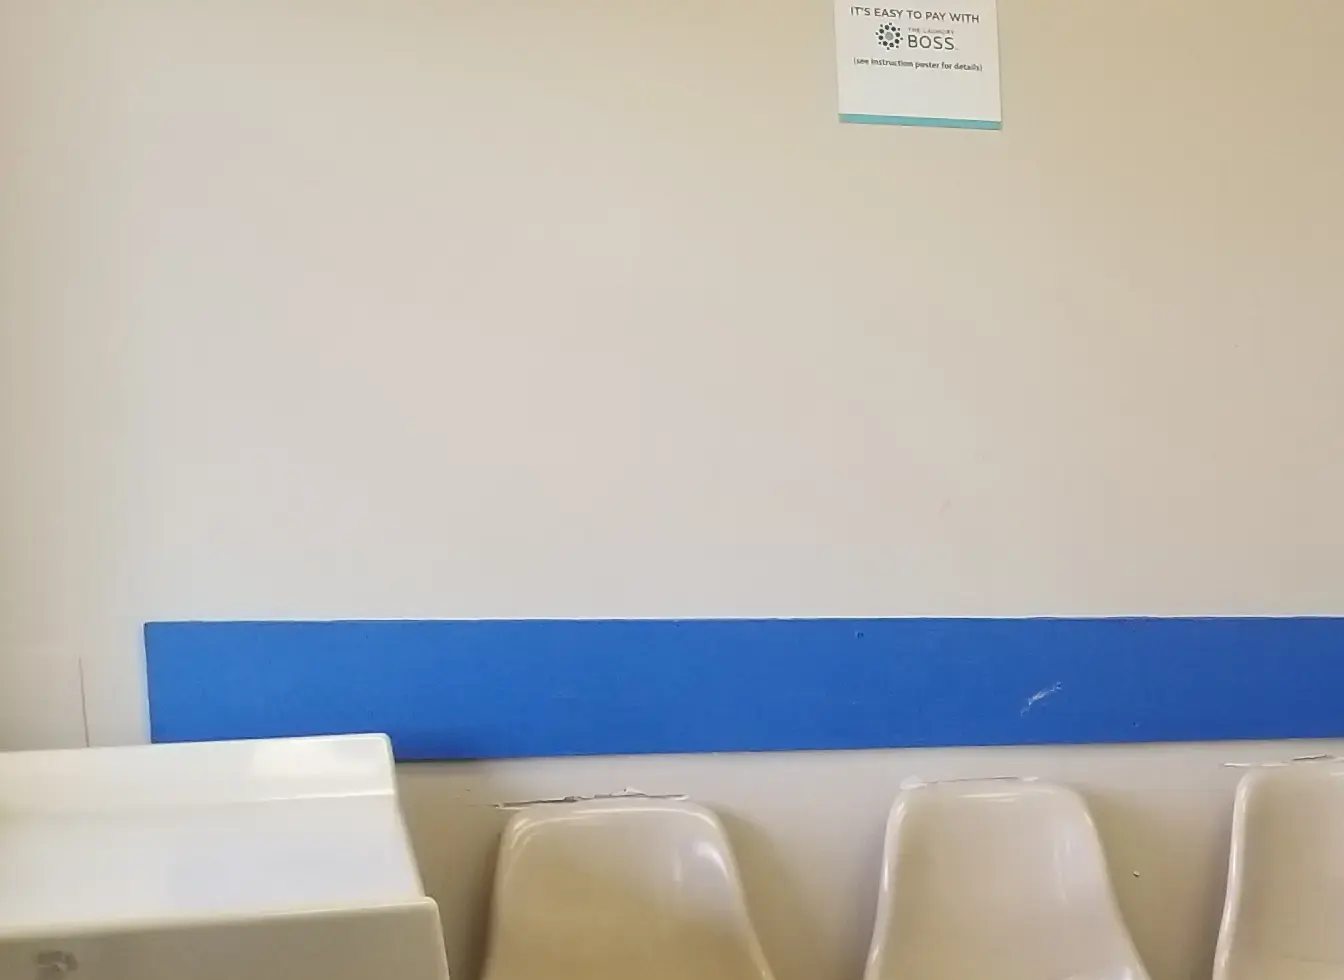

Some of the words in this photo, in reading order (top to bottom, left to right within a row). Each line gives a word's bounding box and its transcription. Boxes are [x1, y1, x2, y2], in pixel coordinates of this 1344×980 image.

[850, 6, 871, 16] IT'S
[874, 8, 903, 19] EASY
[906, 10, 922, 20] TO
[926, 11, 946, 21] PAY
[949, 13, 980, 24] WITH
[907, 34, 955, 51] BOSS
[915, 61, 940, 69] poster
[941, 61, 952, 69] for
